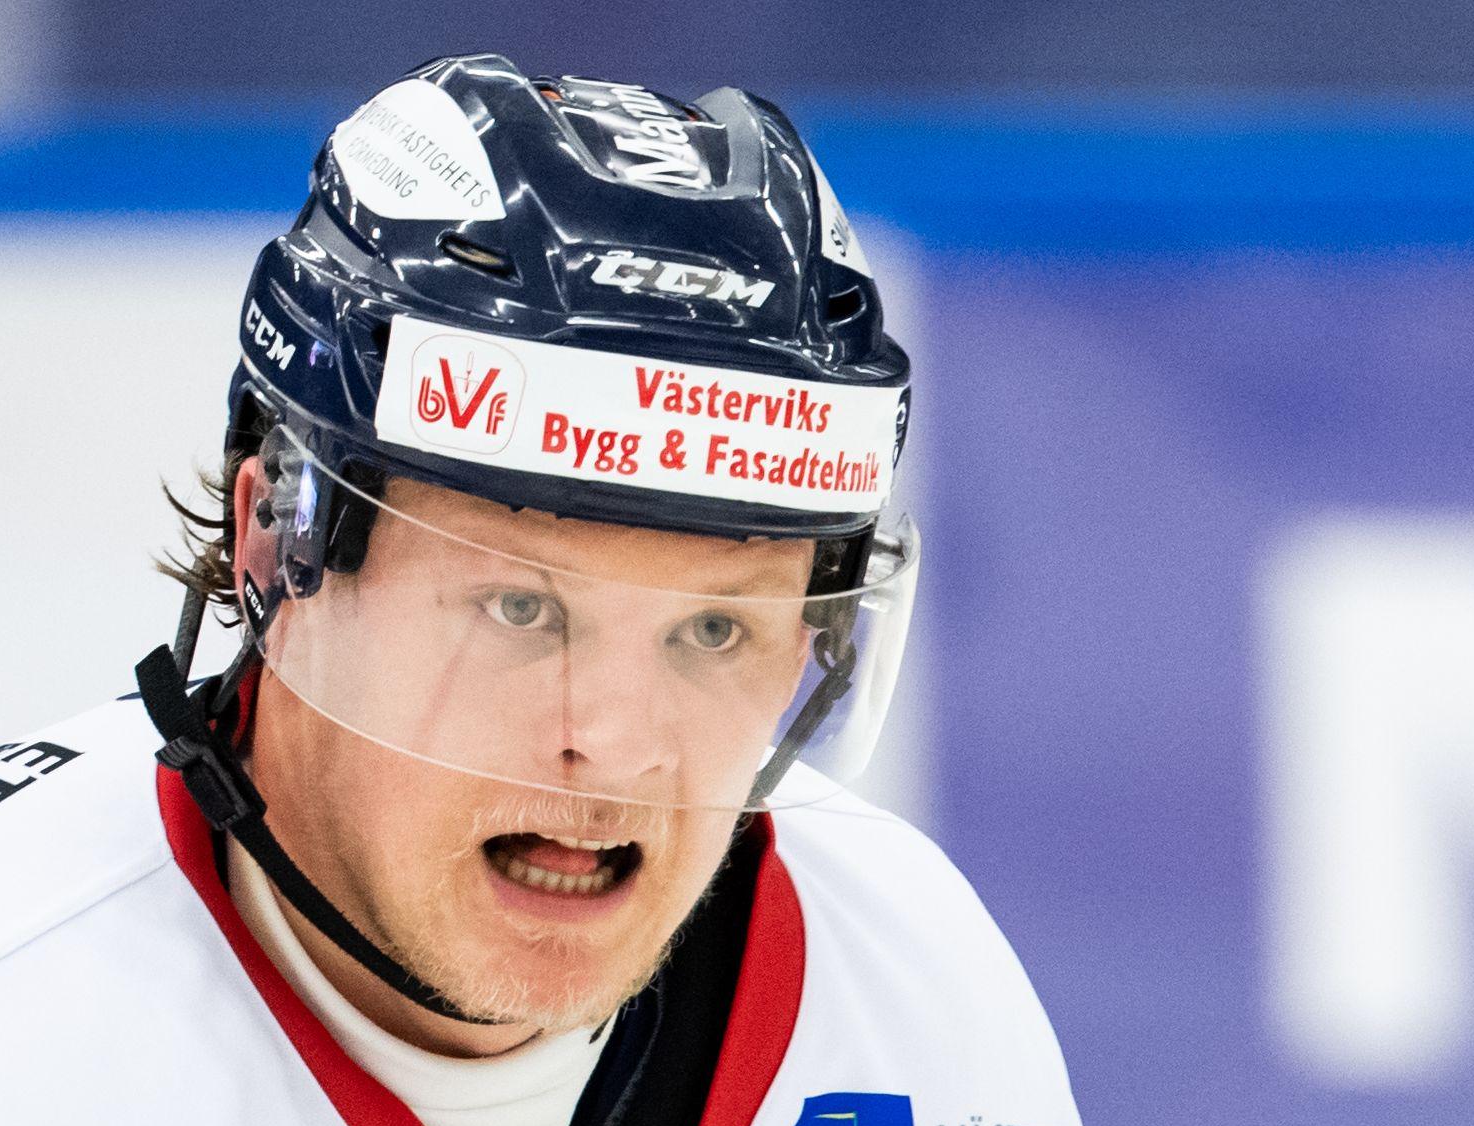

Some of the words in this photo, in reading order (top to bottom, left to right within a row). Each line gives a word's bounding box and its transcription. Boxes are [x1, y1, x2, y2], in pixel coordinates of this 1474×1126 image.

[591, 254, 775, 308] CCM
[245, 302, 296, 371] CCM
[635, 366, 832, 433] Västerviks
[541, 411, 641, 475] Bygg
[659, 428, 688, 470] &
[706, 434, 881, 493] Fasadteknik
